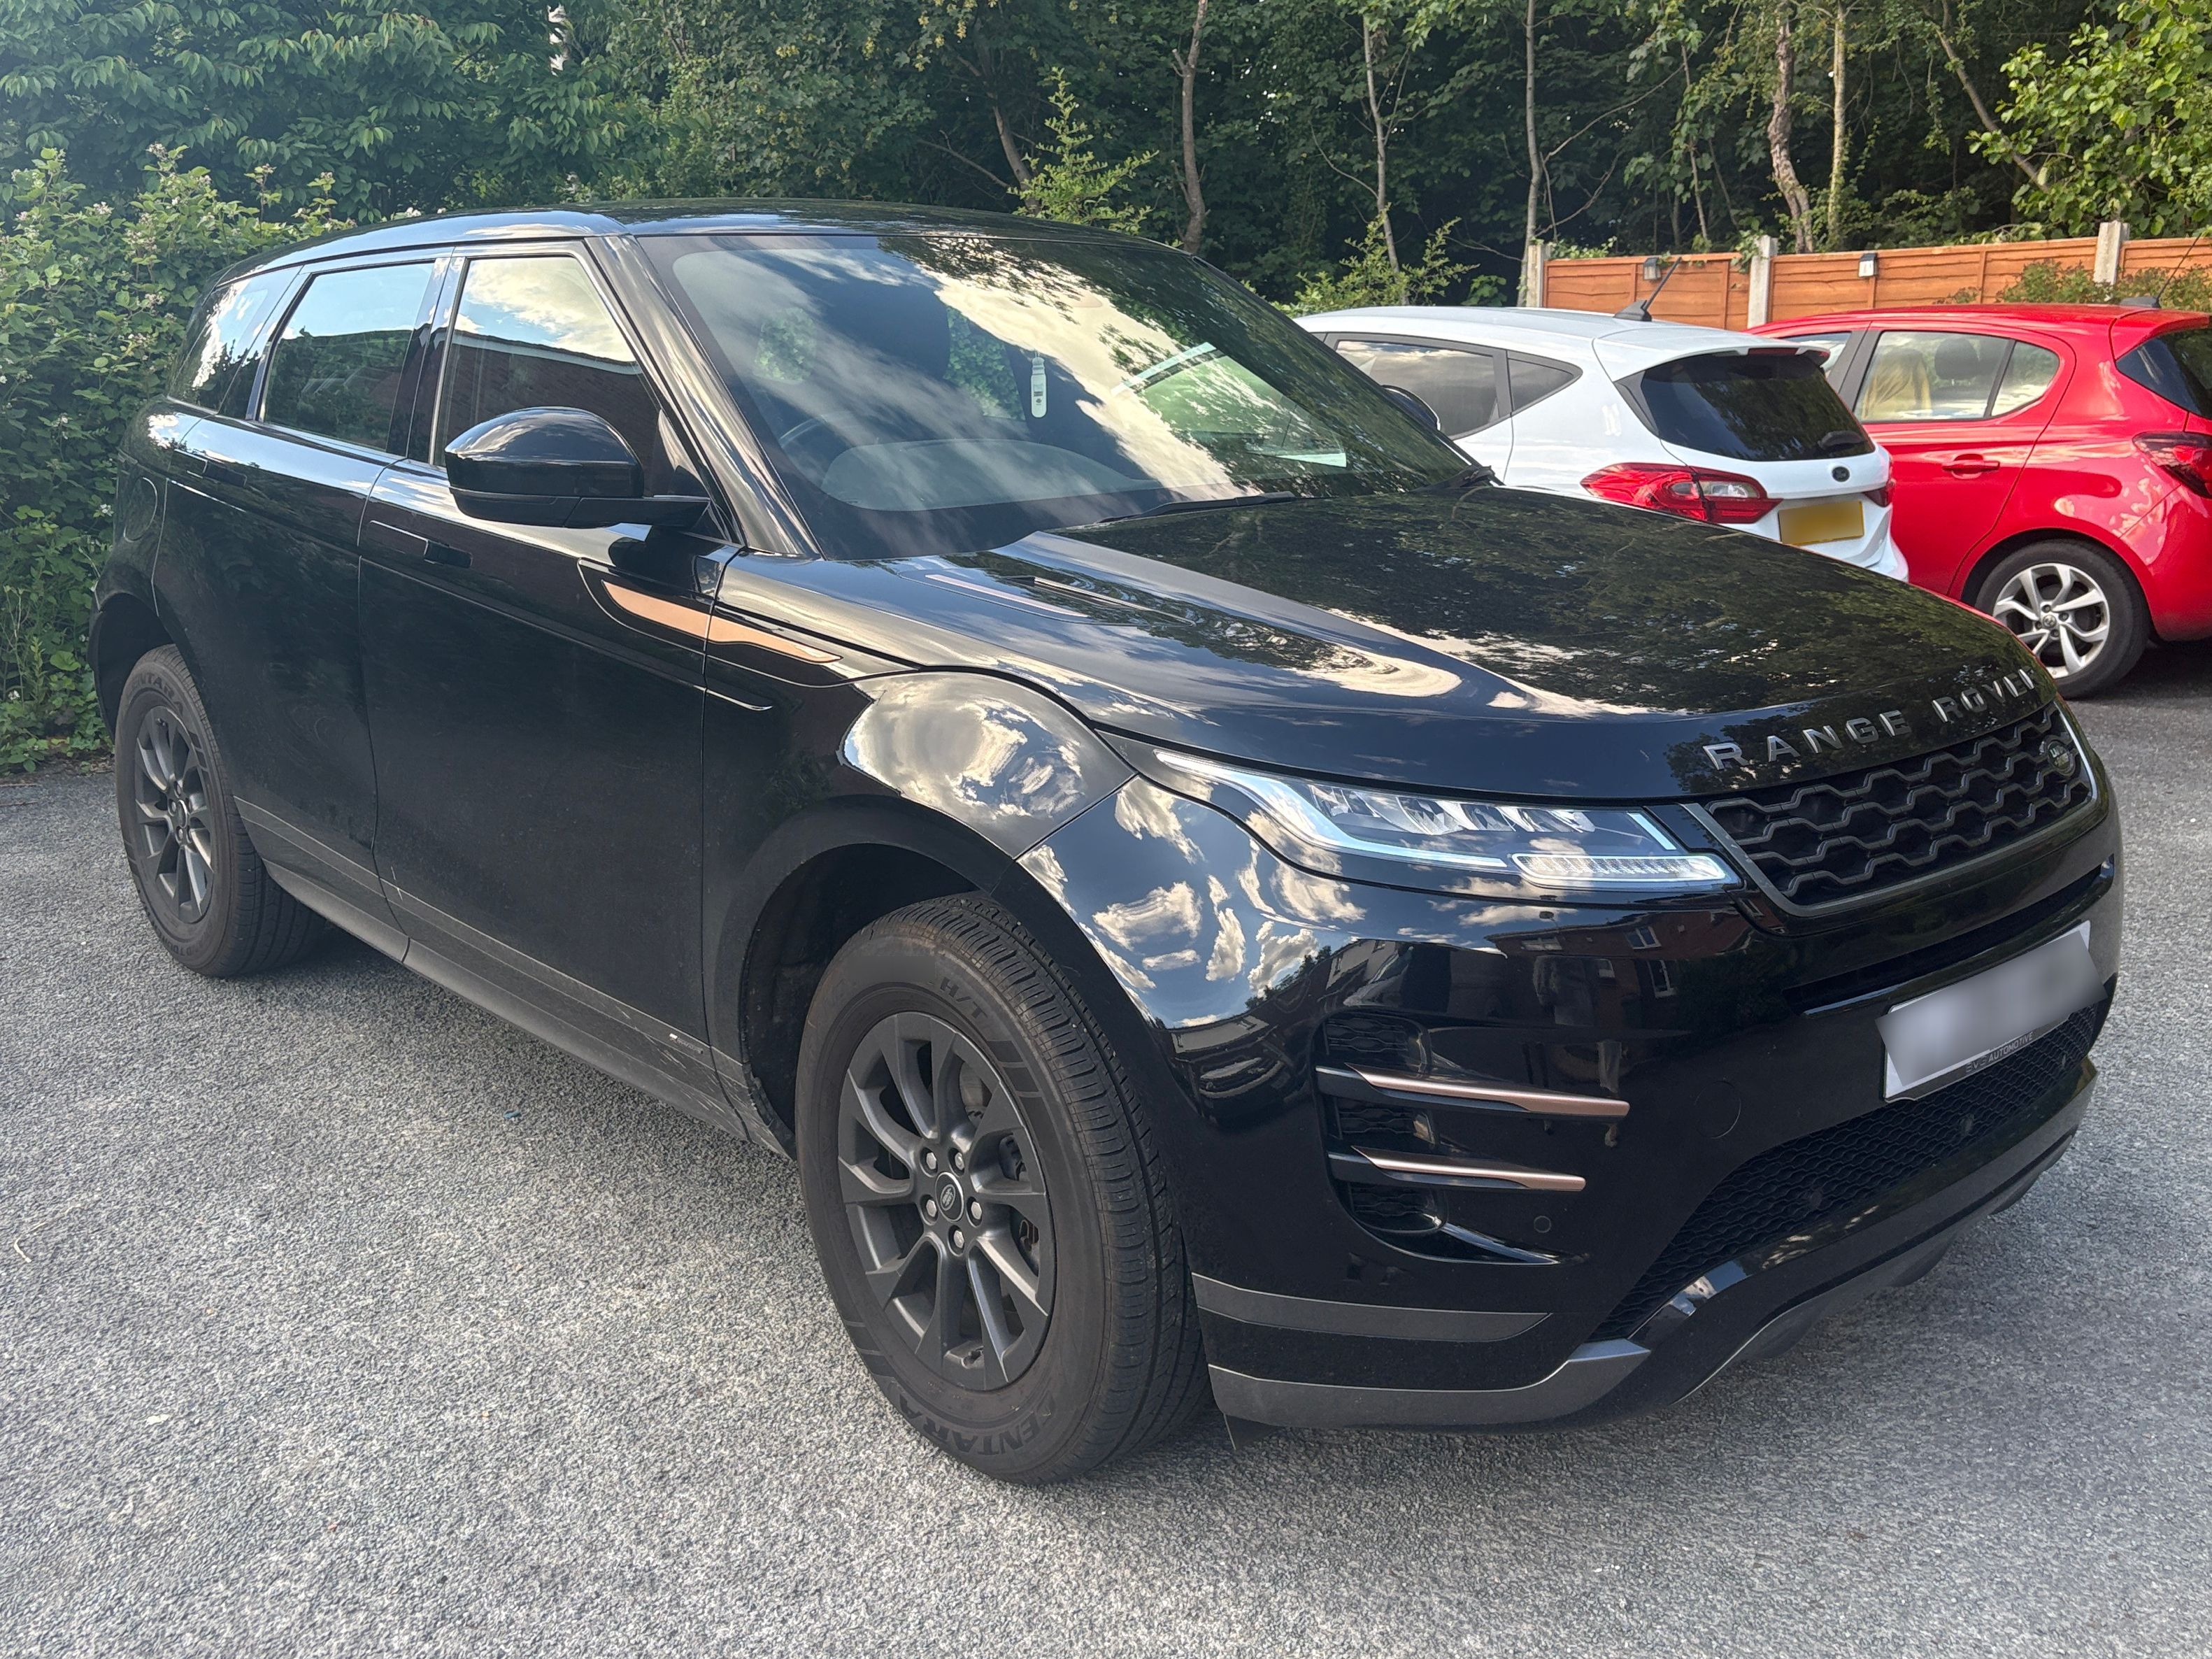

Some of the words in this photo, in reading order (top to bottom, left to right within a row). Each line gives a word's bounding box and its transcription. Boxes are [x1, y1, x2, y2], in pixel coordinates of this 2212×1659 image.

[129, 672, 184, 715] ENTARA
[1702, 710, 1912, 771] RANGE
[940, 976, 988, 1019] H/T
[1988, 1032, 2034, 1063] AUTOMOTIVE
